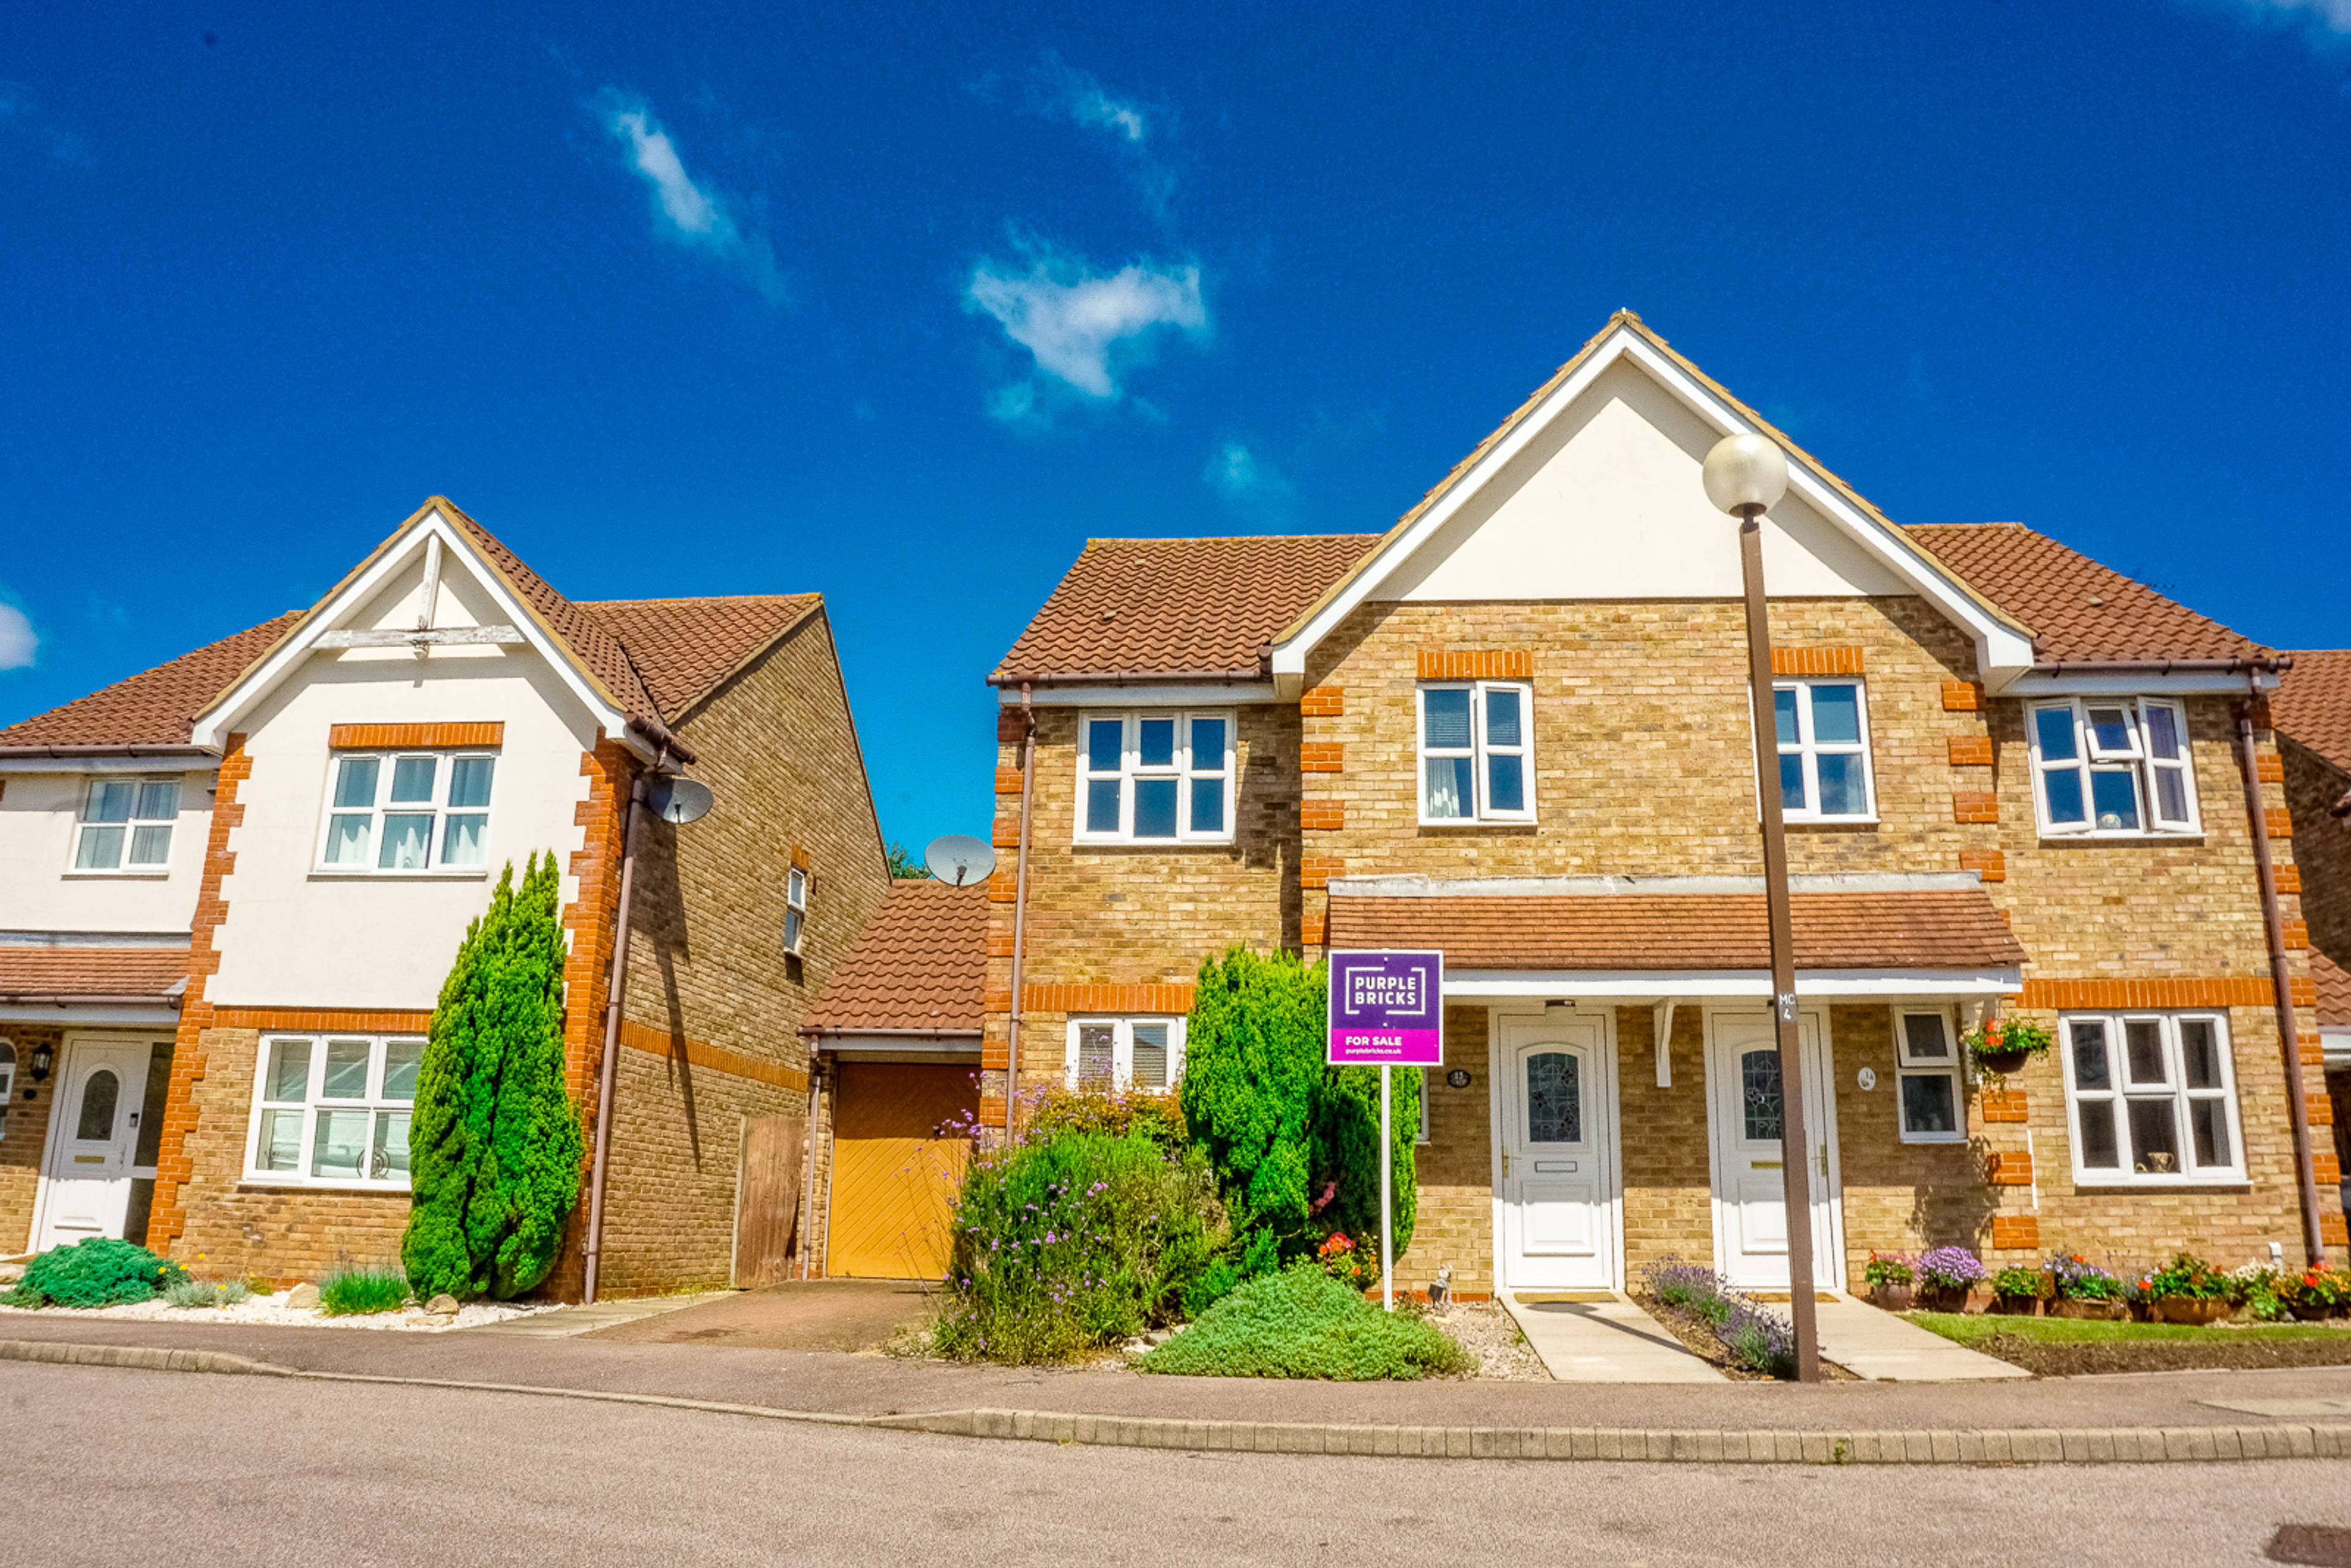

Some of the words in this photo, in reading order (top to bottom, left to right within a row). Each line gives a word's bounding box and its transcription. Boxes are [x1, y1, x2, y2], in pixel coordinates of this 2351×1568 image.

[1355, 977, 1416, 990] PURPLE
[1355, 991, 1416, 1005] BRICKS
[1779, 994, 1795, 1005] MC
[1783, 1008, 1791, 1020] 4
[1346, 1036, 1370, 1046] FOR
[1372, 1036, 1402, 1046] SALE
